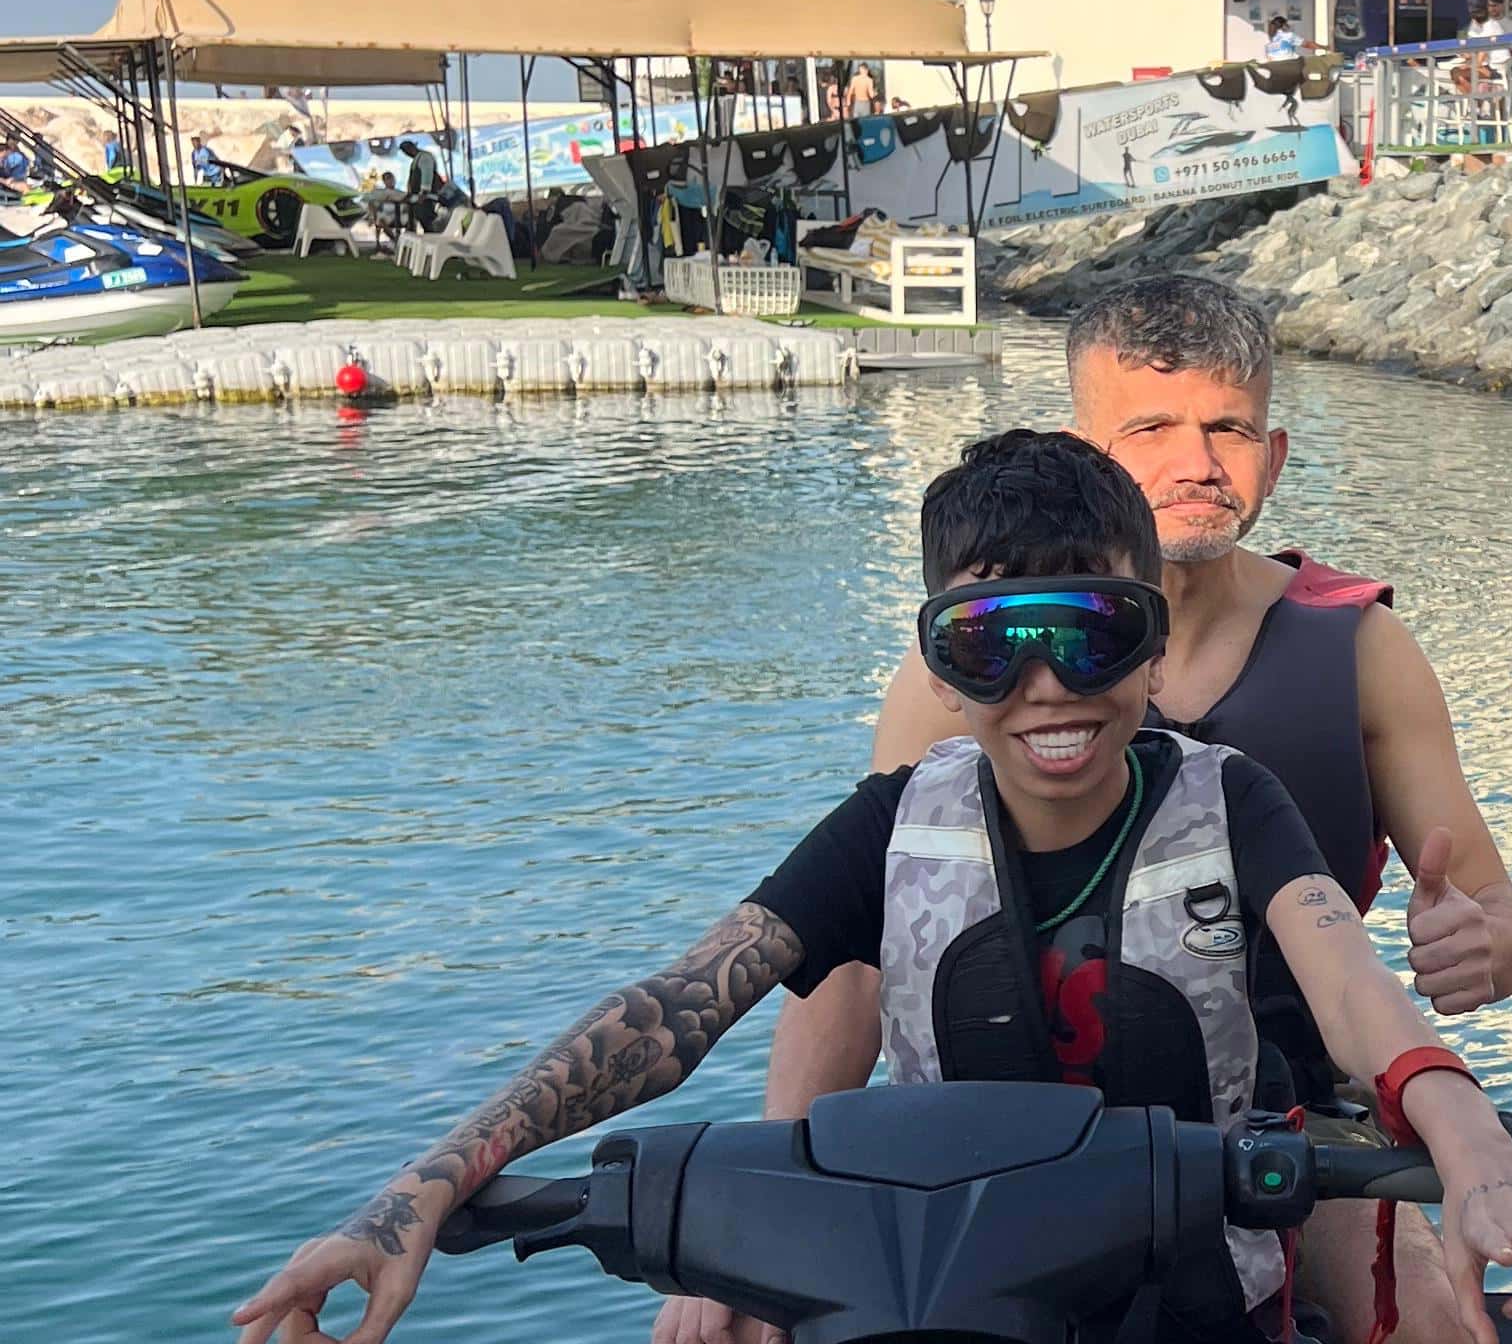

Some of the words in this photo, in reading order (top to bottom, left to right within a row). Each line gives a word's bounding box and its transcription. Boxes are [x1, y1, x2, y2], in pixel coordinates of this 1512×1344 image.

[1083, 92, 1181, 139] WATERSPORTS
[1117, 118, 1160, 146] DUBAI
[1174, 163, 1208, 178] +971
[1212, 158, 1230, 173] 50
[1233, 155, 1259, 170] 496
[1262, 150, 1297, 166] 6664
[1026, 207, 1079, 221] ELECTRIC
[1081, 196, 1145, 213] SURFBOARD
[1153, 187, 1198, 201] BANANA
